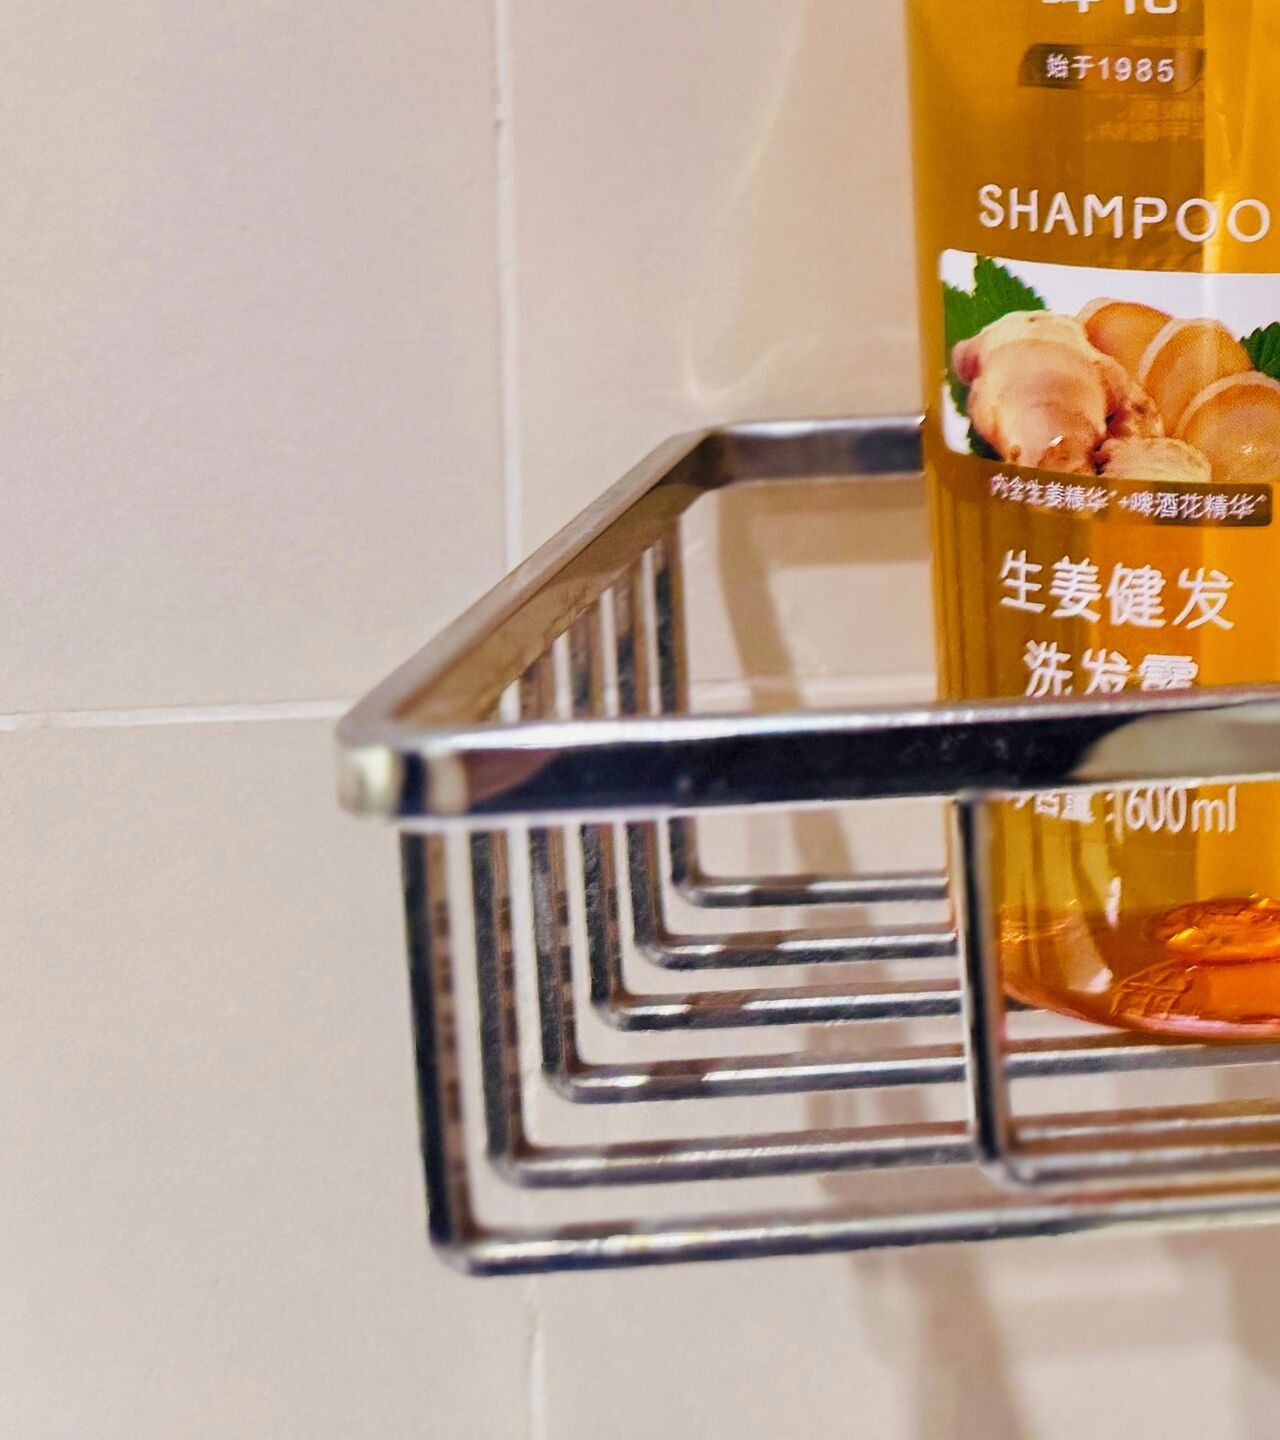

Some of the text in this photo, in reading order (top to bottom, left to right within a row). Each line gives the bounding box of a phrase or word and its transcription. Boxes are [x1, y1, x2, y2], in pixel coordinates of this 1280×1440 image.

[1045, 53, 1175, 83] 始于1985
[978, 183, 1271, 243] SHAMPOO
[999, 549, 1235, 631] 生姜健发
